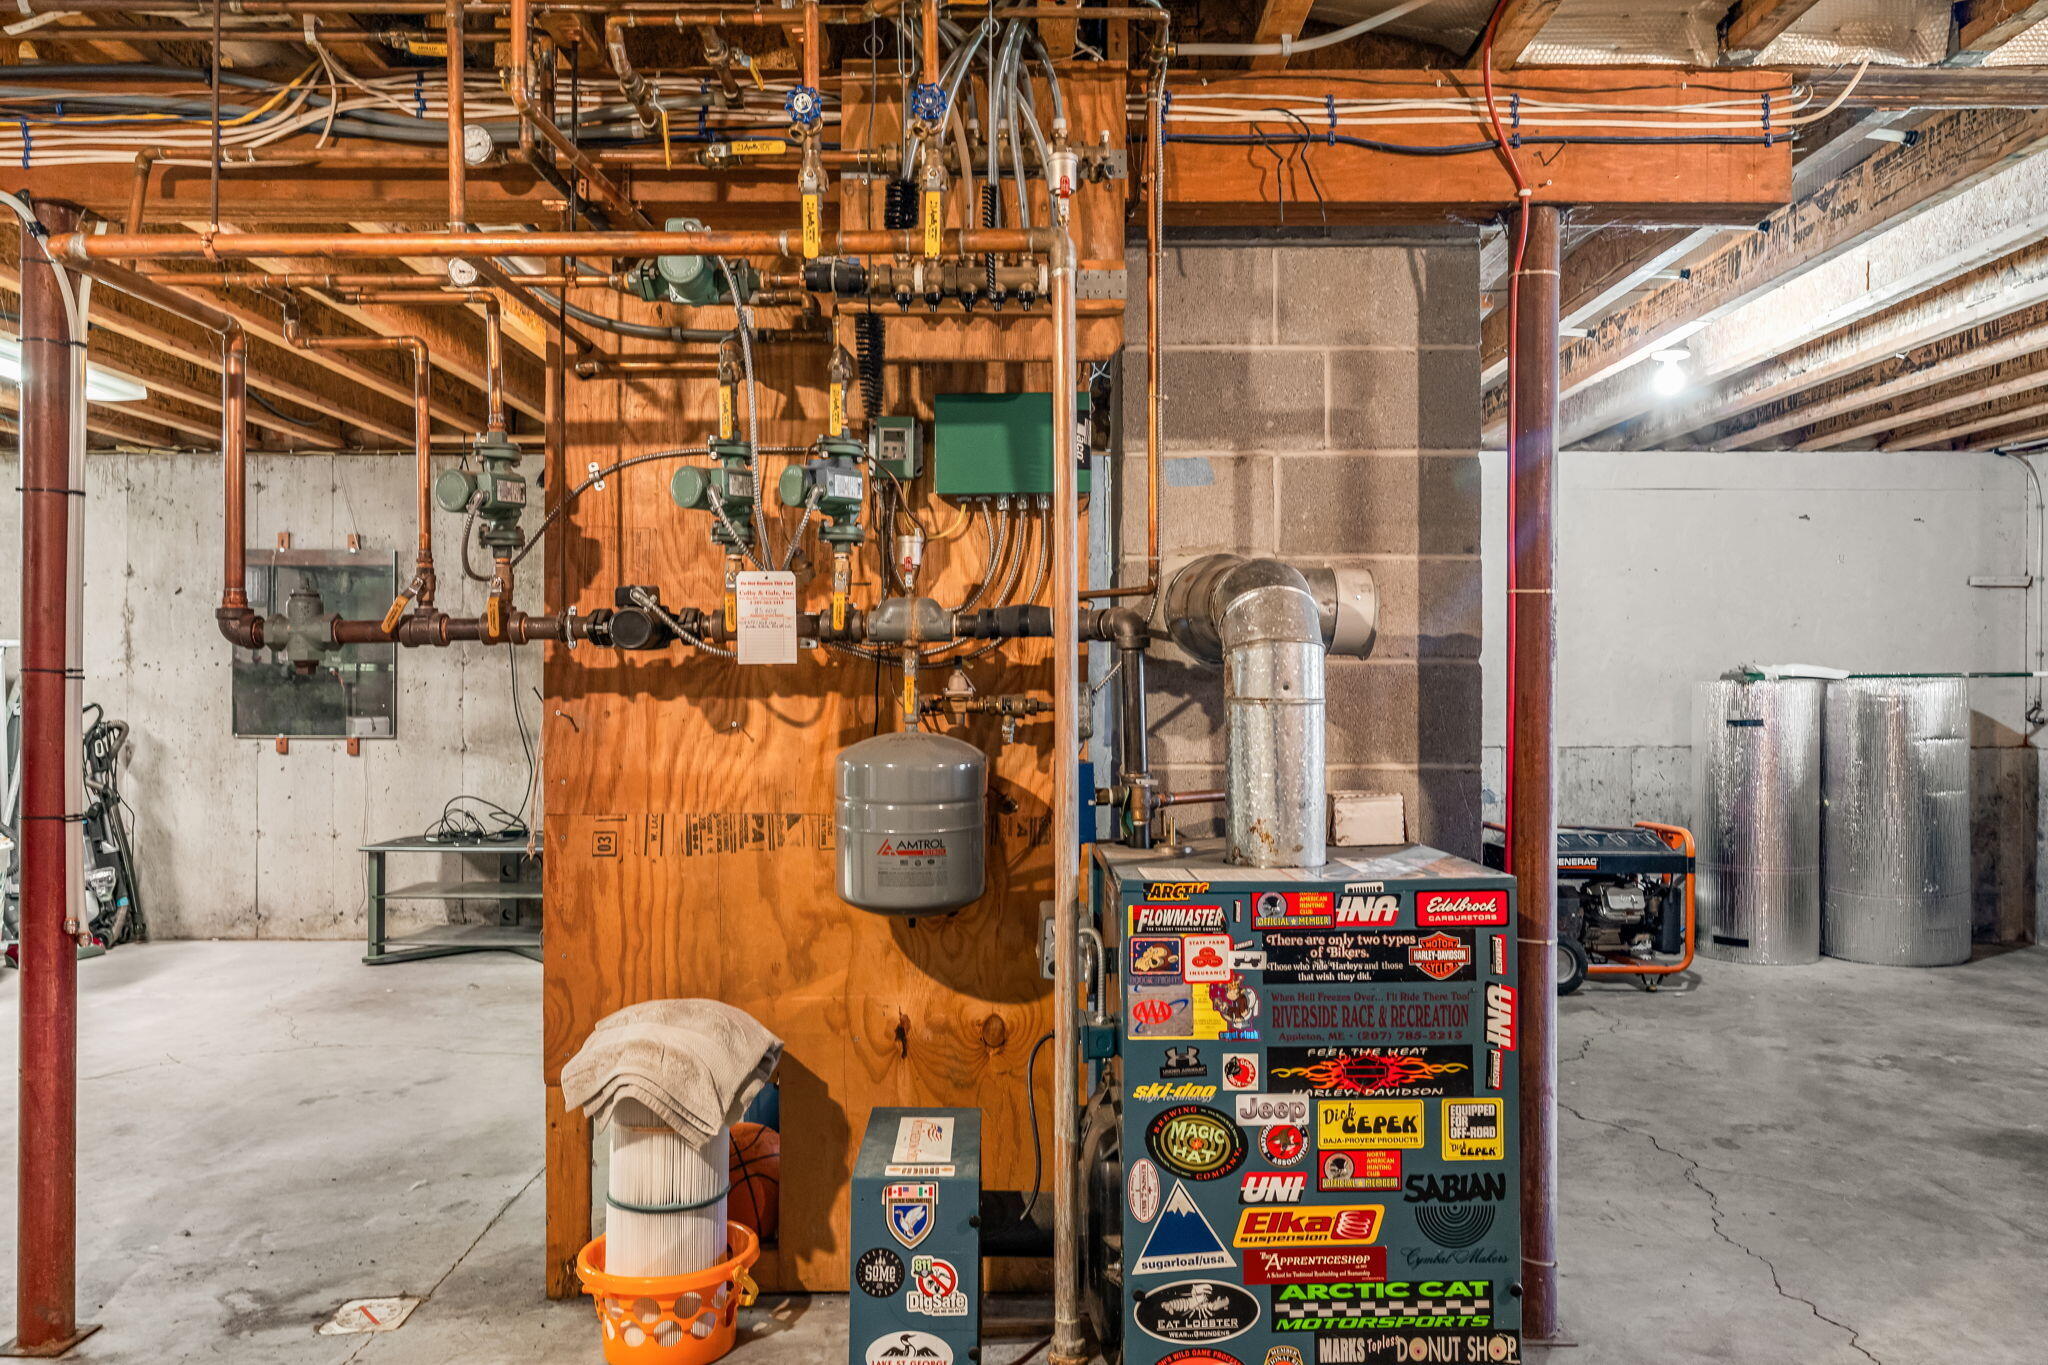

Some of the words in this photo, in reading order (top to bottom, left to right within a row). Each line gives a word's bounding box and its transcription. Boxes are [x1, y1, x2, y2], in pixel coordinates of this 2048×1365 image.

[597, 836, 612, 852] 03
[896, 839, 946, 850] AMTROL
[1427, 896, 1497, 914] Edelbrock
[1137, 909, 1223, 932] FLOWMASTER
[1257, 917, 1289, 926] OFFICIAL
[1299, 917, 1329, 926] MEMBER
[1428, 914, 1498, 922] CARBURETORS
[1266, 934, 1303, 946] There
[1304, 936, 1325, 945] are
[1328, 933, 1354, 947] only
[1357, 934, 1380, 945] two
[1382, 934, 1416, 948] types
[1310, 946, 1323, 958] of
[1327, 946, 1370, 959] Bikers.
[1413, 949, 1466, 961] HARLEY-DAVIDSON
[1266, 962, 1291, 971] Those
[1293, 962, 1309, 971] who
[1312, 960, 1328, 971] ride
[1329, 961, 1361, 972] Harleys
[1364, 961, 1378, 970] and
[1382, 961, 1404, 970] those
[1298, 973, 1314, 981] that
[1316, 972, 1335, 981] wish
[1337, 972, 1355, 983] they
[1357, 972, 1372, 981] did.
[1271, 992, 1295, 1001] When
[1298, 992, 1315, 1001] Hell
[1318, 992, 1351, 1001] Freezes
[1400, 991, 1419, 1001] Ride
[1423, 991, 1448, 1001] There
[1133, 1000, 1172, 1024] AAA
[1272, 1004, 1339, 1028] RIVERSIDE
[1342, 1004, 1376, 1028] RACE
[1378, 1004, 1387, 1027] &
[1390, 1004, 1469, 1028] RECREATION
[1279, 1032, 1325, 1042] Appleton,
[1328, 1031, 1345, 1041] ME
[1357, 1030, 1392, 1041] (207)
[1307, 1048, 1346, 1058] FEEL
[1351, 1047, 1381, 1057] THE
[1392, 1046, 1428, 1057] HEAT
[1133, 1082, 1217, 1098] ski-doo
[1240, 1097, 1307, 1122] Jeep
[1323, 1102, 1356, 1125] Dick
[1450, 1104, 1496, 1116] EQUIPPED
[1153, 1105, 1197, 1134] BREWING
[1341, 1115, 1418, 1134] CEPEK
[1450, 1116, 1469, 1127] FOR
[1170, 1121, 1225, 1145] MAGIC
[1450, 1126, 1496, 1139] OFF-ROAD
[1172, 1145, 1217, 1164] HAT
[1451, 1141, 1466, 1152] Dick
[1460, 1147, 1497, 1156] CEPEK
[1196, 1147, 1242, 1180] COMPANY
[1242, 1176, 1304, 1202] UNI
[1323, 1178, 1356, 1188] OFFICIAL
[1365, 1178, 1397, 1188] MEMBER
[1403, 1172, 1506, 1203] SABIAN
[1243, 1211, 1332, 1235] Elka
[1240, 1234, 1328, 1244] suspension
[915, 1259, 932, 1272] 811
[1141, 1255, 1225, 1271] sugarloaf/usa
[1265, 1252, 1371, 1271] APPRENTICESHOP
[1400, 1247, 1452, 1270] Cymbal
[1452, 1247, 1508, 1265] Makers
[1279, 1281, 1410, 1300] ARCTIC
[1419, 1281, 1490, 1298] CAT
[909, 1292, 966, 1313] DigSafe
[1157, 1319, 1180, 1329] EAT
[1185, 1317, 1239, 1328] LOBSTER
[1276, 1315, 1491, 1331] MOTORSPORTS
[1172, 1350, 1190, 1360] WILD
[1191, 1348, 1212, 1357] GAME
[1271, 1348, 1297, 1356] MEMBER
[1319, 1337, 1366, 1363] MARKS
[1366, 1335, 1400, 1354] Topless
[1397, 1336, 1461, 1363] DONUT
[1467, 1334, 1518, 1363] SHOP
